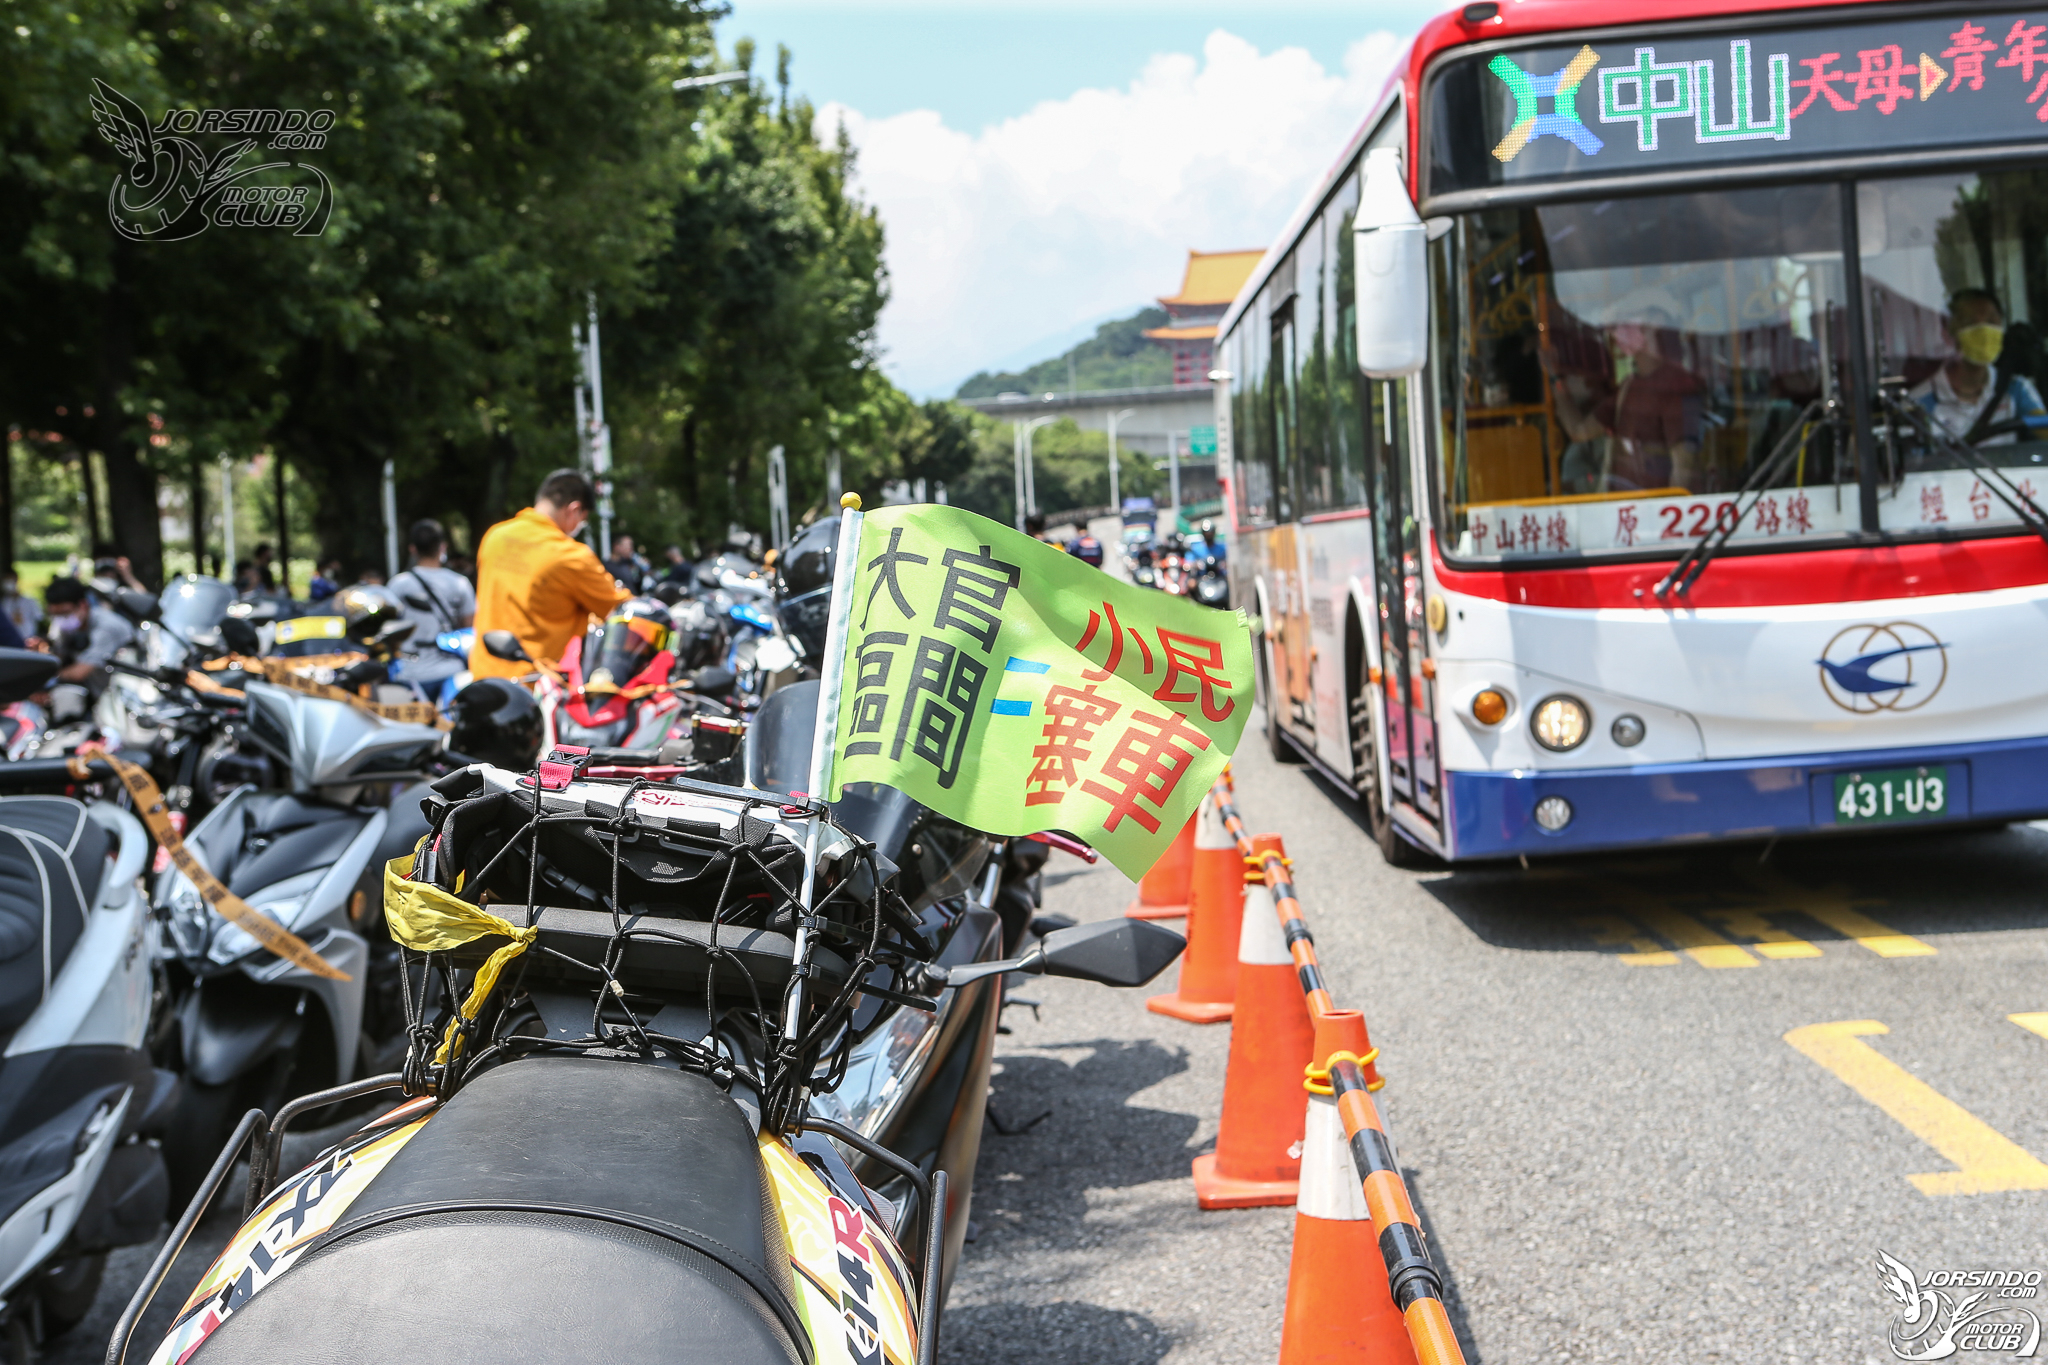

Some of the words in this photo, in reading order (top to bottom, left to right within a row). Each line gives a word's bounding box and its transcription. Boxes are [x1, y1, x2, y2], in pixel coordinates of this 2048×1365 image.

[1598, 39, 1791, 151] 中山
[1789, 44, 1920, 119] 天母
[1469, 511, 1570, 554] 中山幹線
[1659, 501, 1741, 540] 220
[1755, 489, 1813, 535] 路線
[859, 527, 1021, 654] 大官
[1074, 601, 1236, 722] 小民
[1024, 684, 1213, 834] 塞車
[1838, 777, 1944, 819] 431-U3
